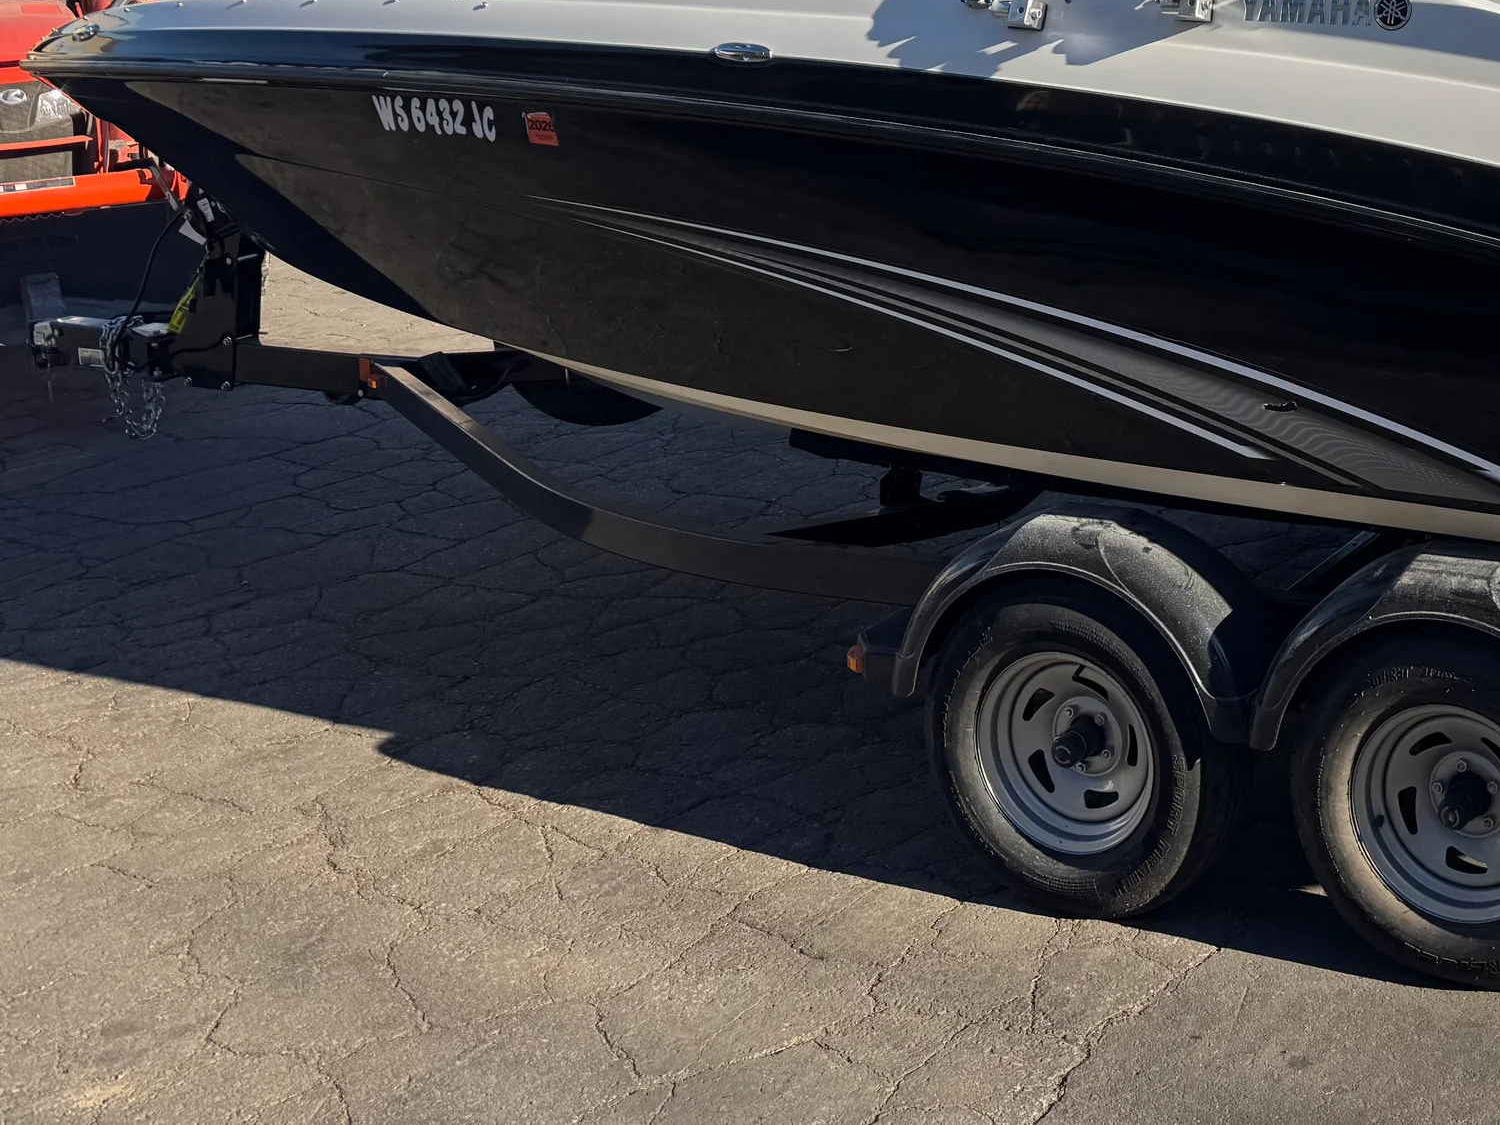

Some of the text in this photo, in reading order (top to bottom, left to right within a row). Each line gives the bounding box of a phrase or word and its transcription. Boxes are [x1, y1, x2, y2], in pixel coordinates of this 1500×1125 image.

[372, 94, 497, 143] WS 6432 JC
[1166, 754, 1187, 837] SPORT
